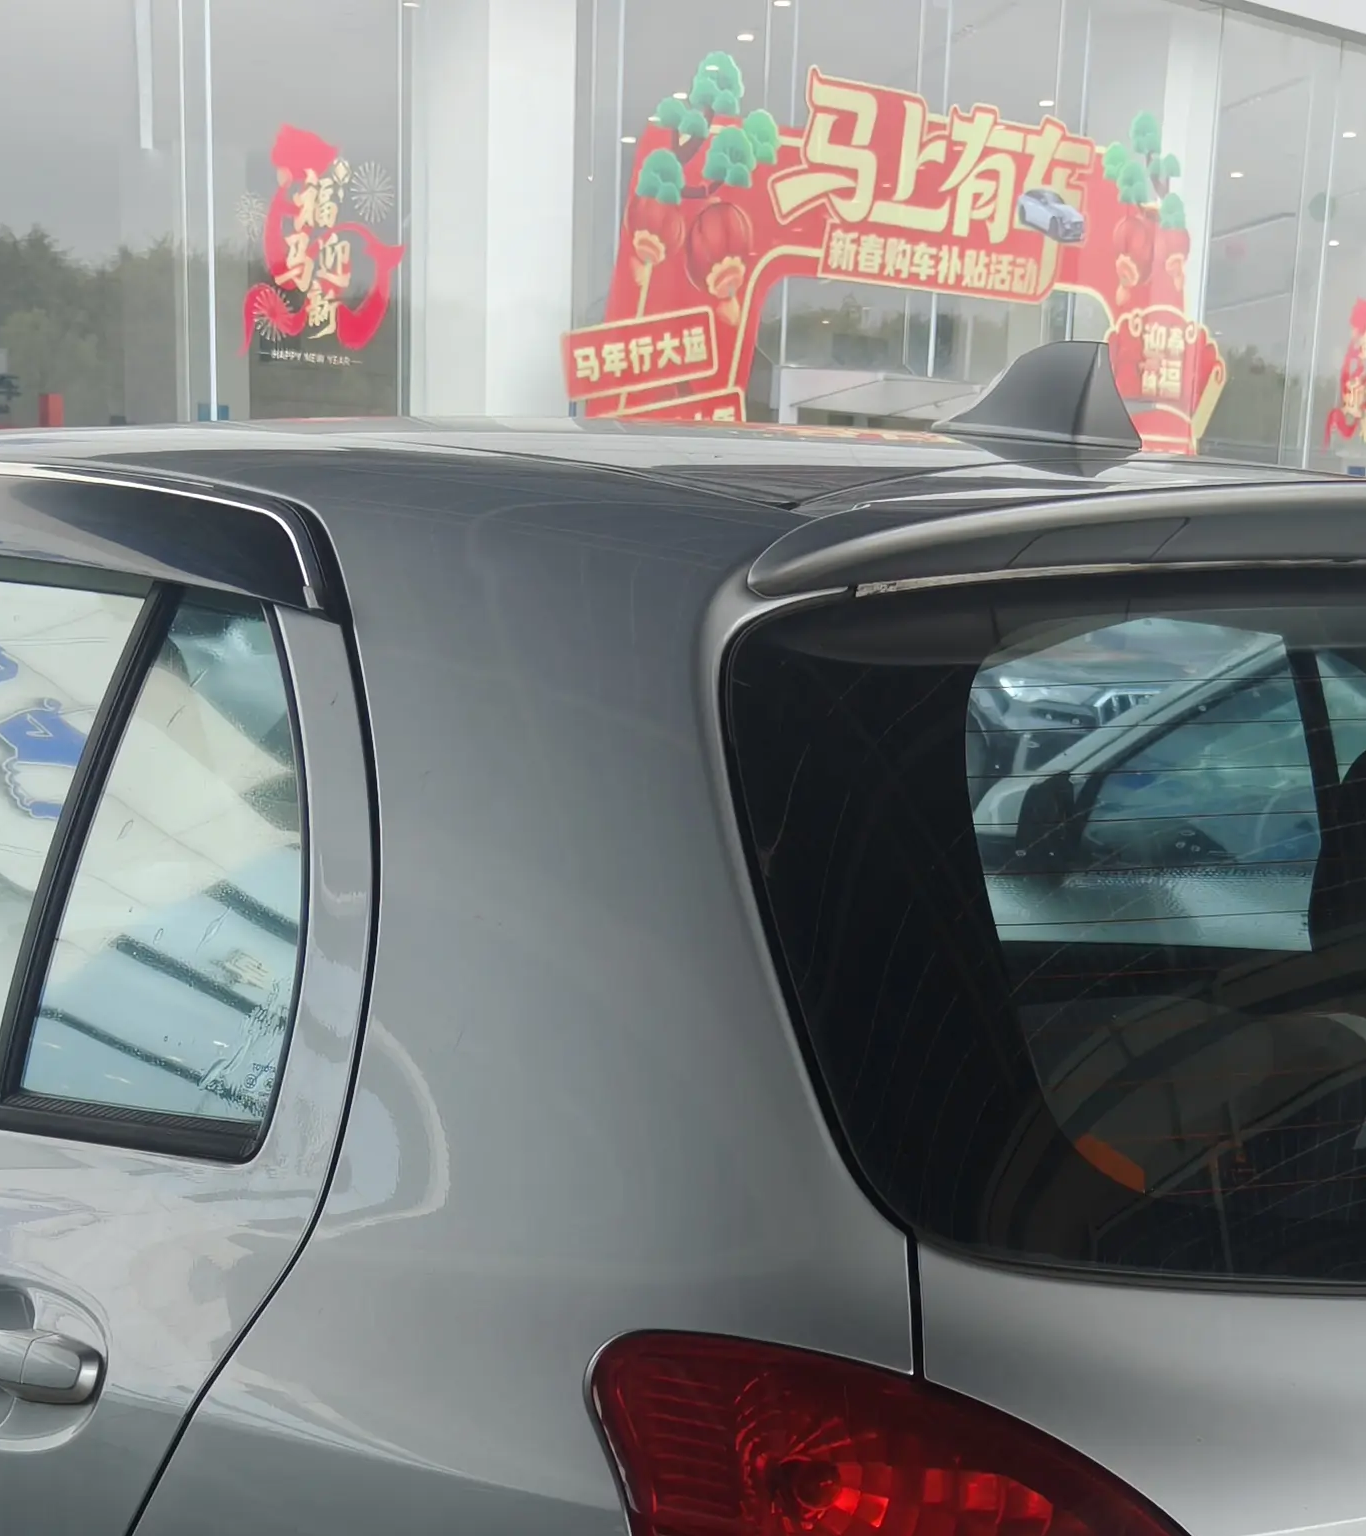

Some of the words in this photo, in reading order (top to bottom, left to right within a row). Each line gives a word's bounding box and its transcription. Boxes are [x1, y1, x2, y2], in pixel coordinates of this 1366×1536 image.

[774, 76, 1092, 296] 马上有车
[827, 229, 1038, 296] 新春购车补贴活动
[573, 326, 708, 382] 马年行大运
